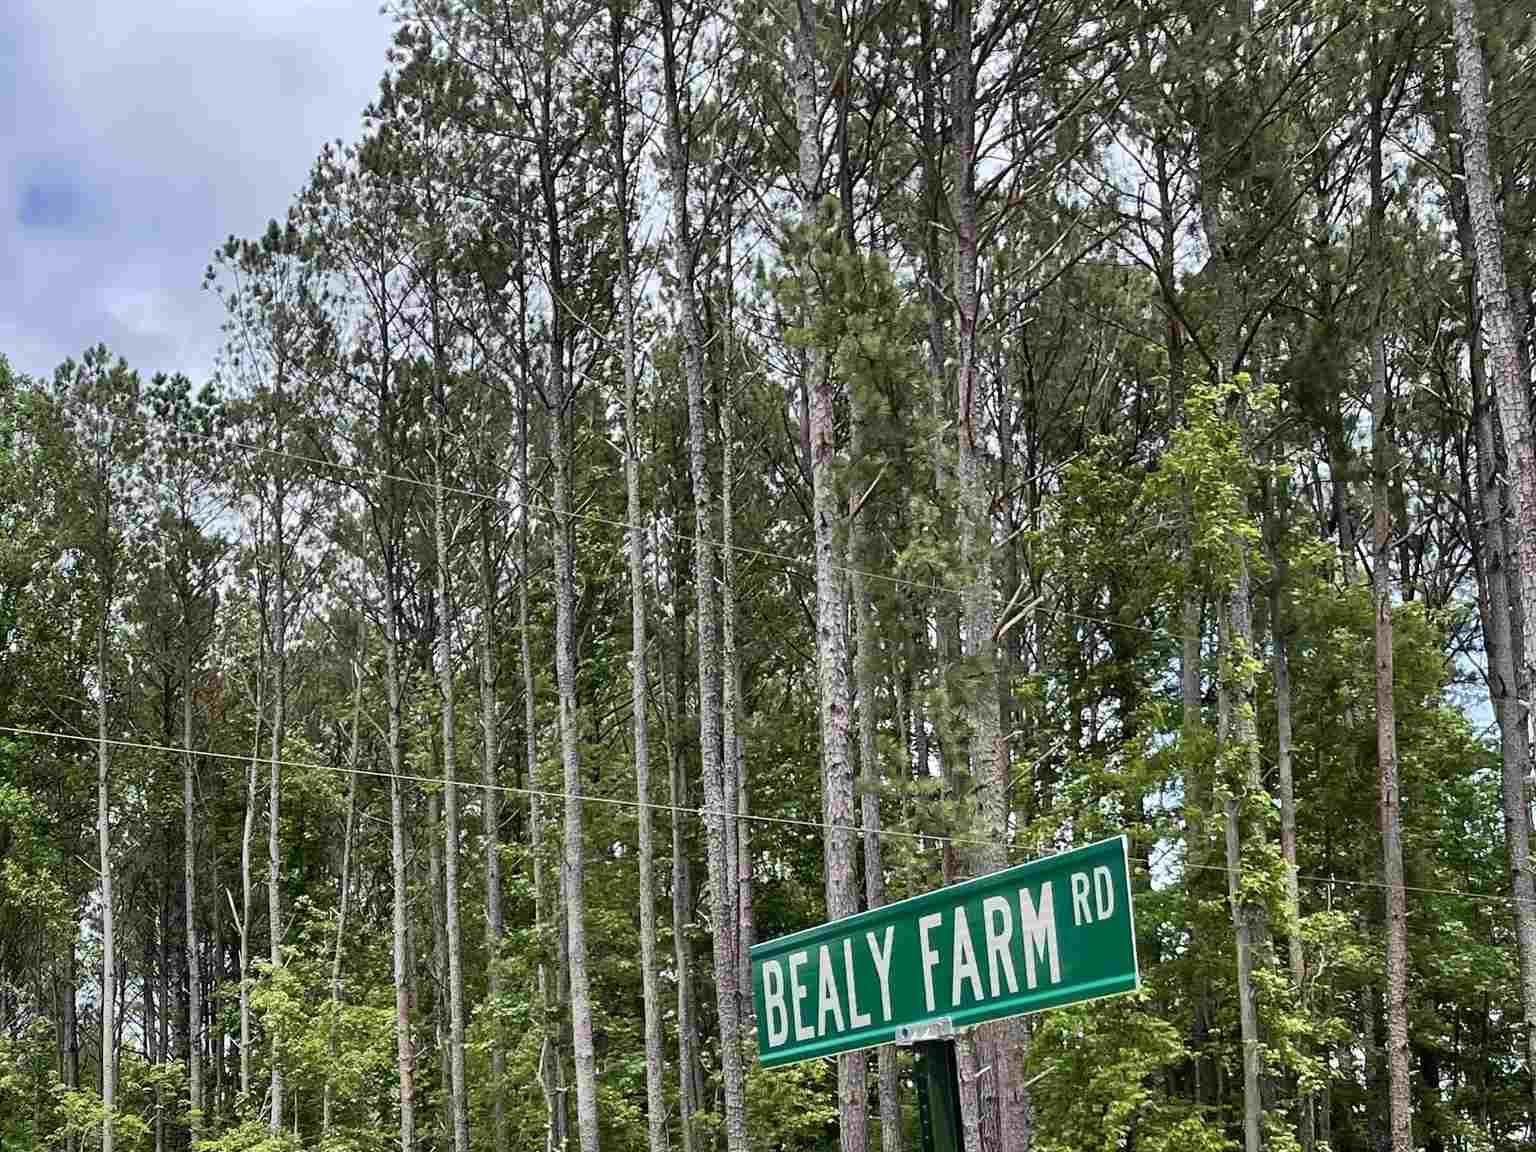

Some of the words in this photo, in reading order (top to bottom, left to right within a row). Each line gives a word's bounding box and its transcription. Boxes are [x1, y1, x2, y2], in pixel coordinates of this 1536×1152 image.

[762, 925, 895, 1048] BEALY
[918, 881, 1062, 1012] FARM
[1071, 865, 1115, 926] RD
